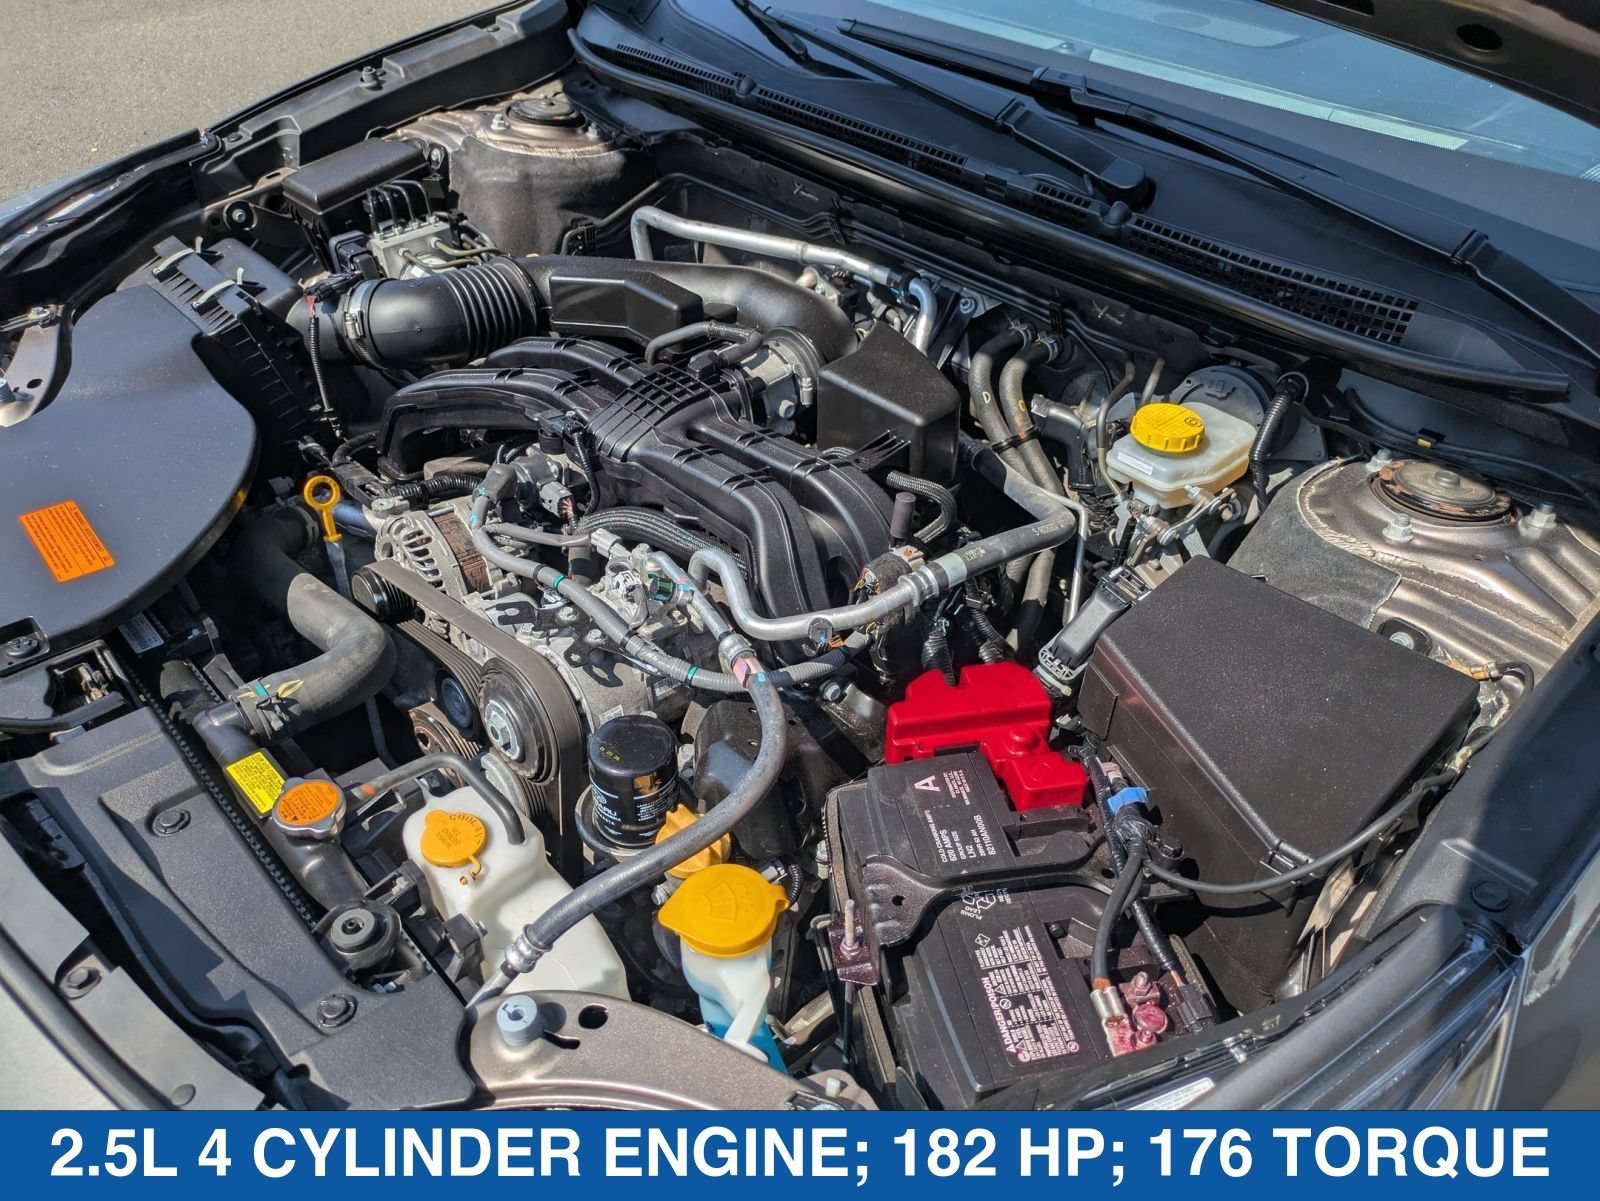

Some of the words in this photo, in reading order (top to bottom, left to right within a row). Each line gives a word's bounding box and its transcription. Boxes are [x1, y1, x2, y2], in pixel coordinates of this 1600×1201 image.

[914, 775, 941, 792] A
[940, 829, 953, 848] AMPS
[939, 849, 948, 863] COLD
[966, 845, 976, 858] LN2
[981, 977, 1013, 1047] DANGER/POISON
